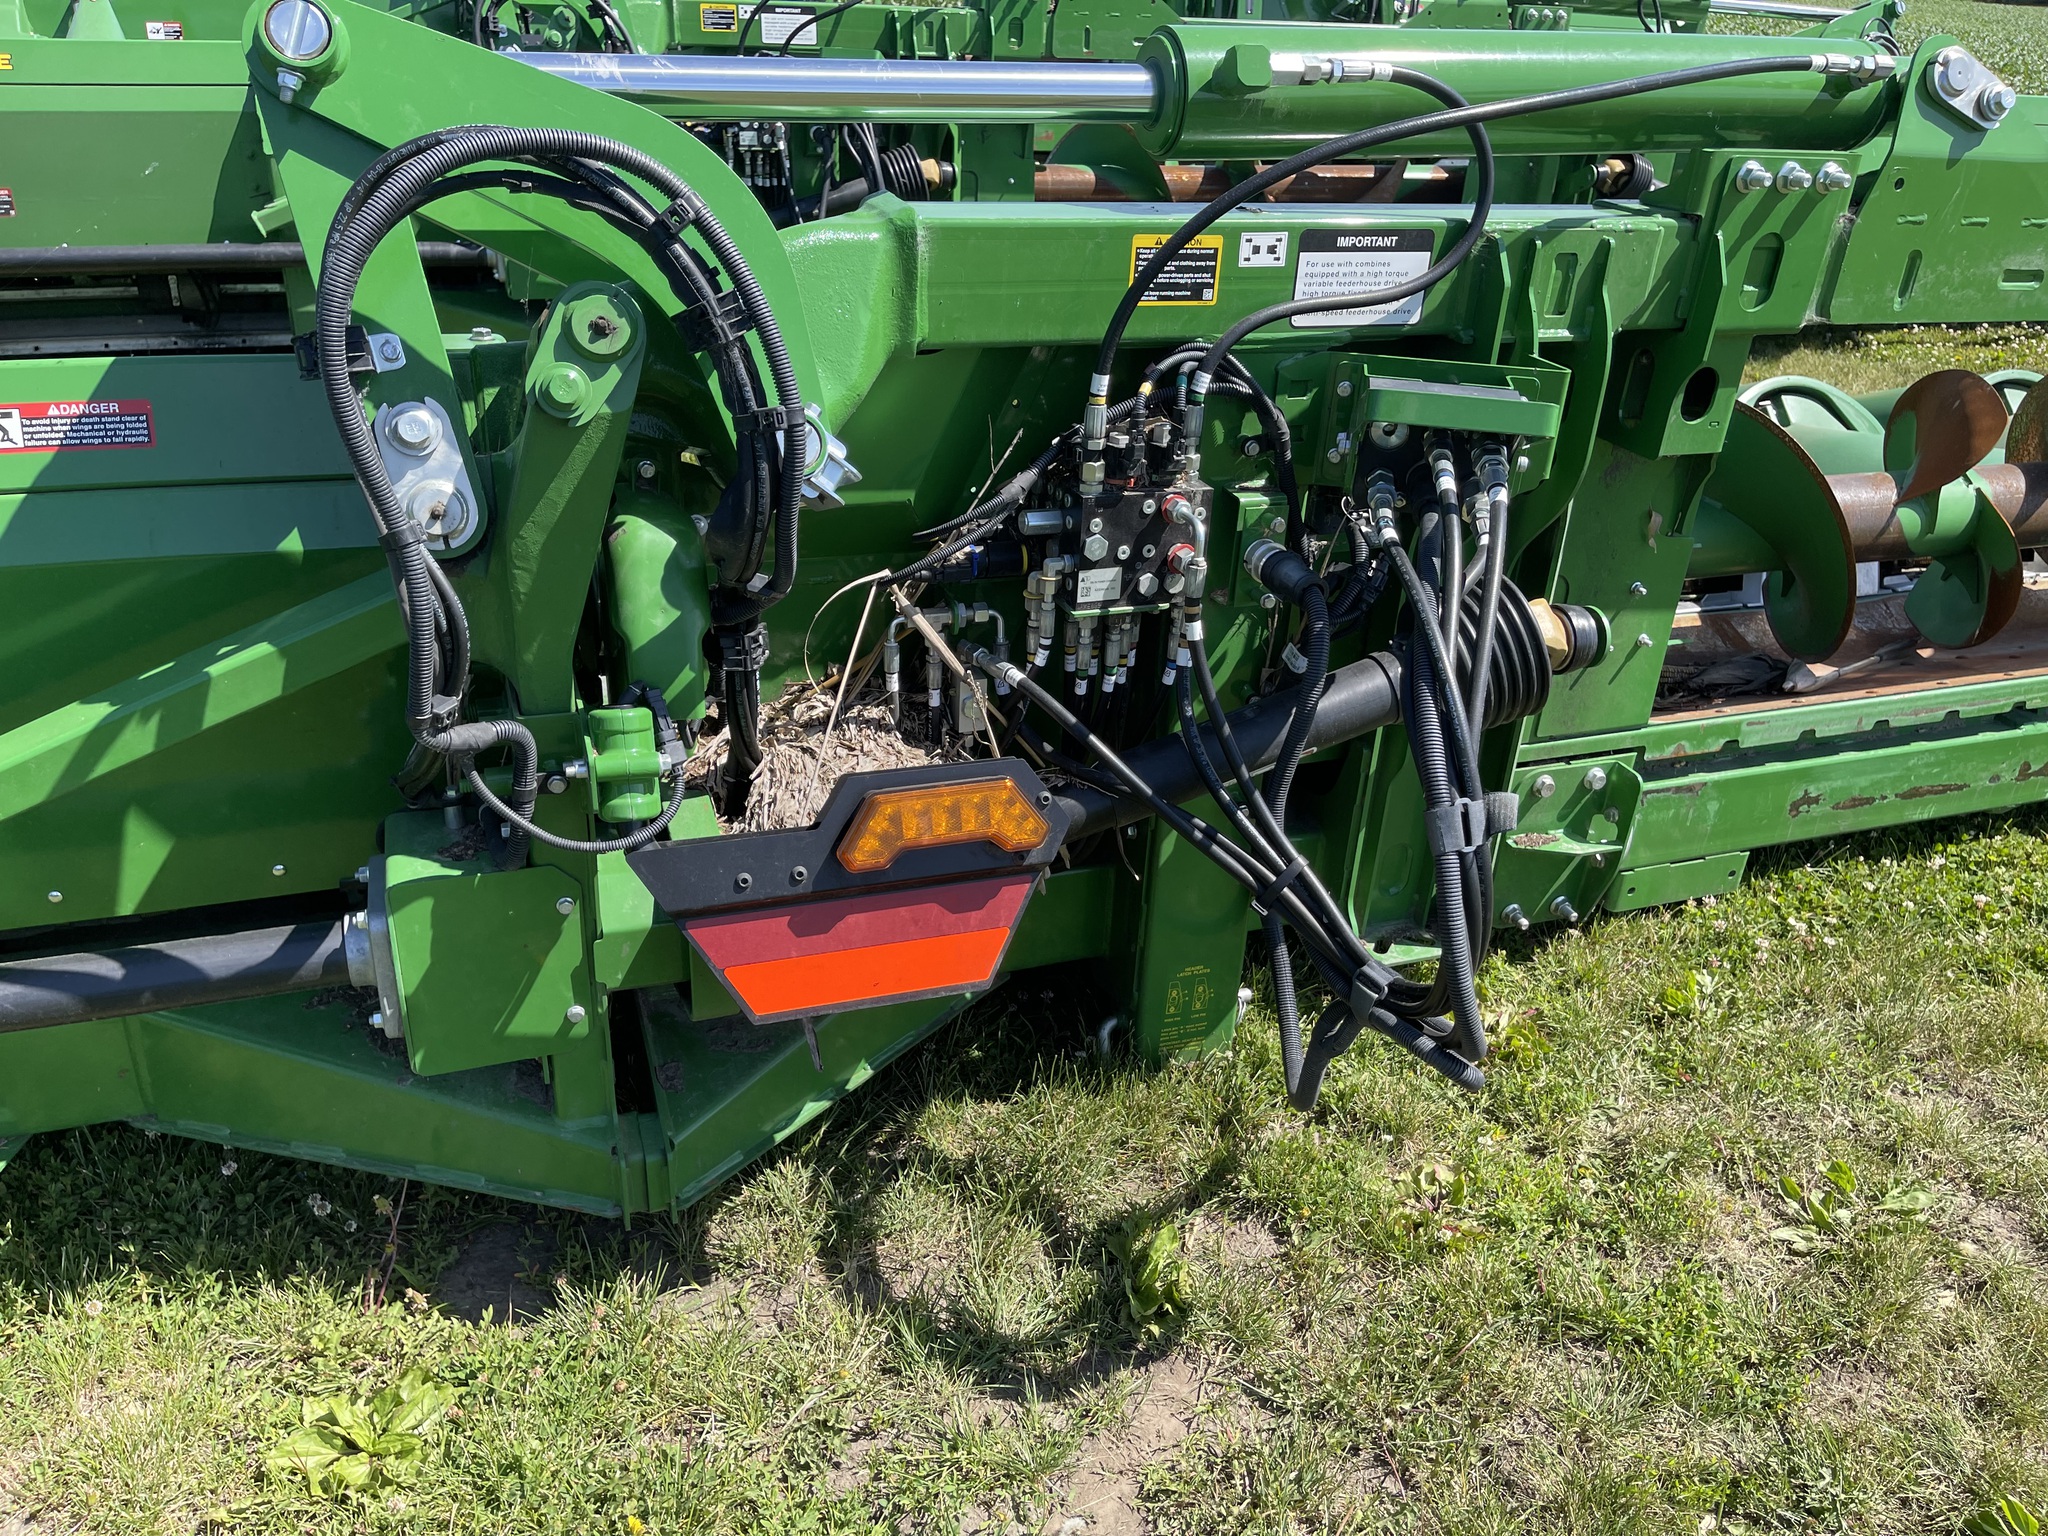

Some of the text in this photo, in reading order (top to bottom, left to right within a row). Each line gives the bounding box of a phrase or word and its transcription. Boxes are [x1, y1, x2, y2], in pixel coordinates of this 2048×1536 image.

[1336, 236, 1398, 247] IMPORTANT
[60, 402, 119, 415] DANGER
[1444, 682, 1465, 742] ALFAGOMMA
